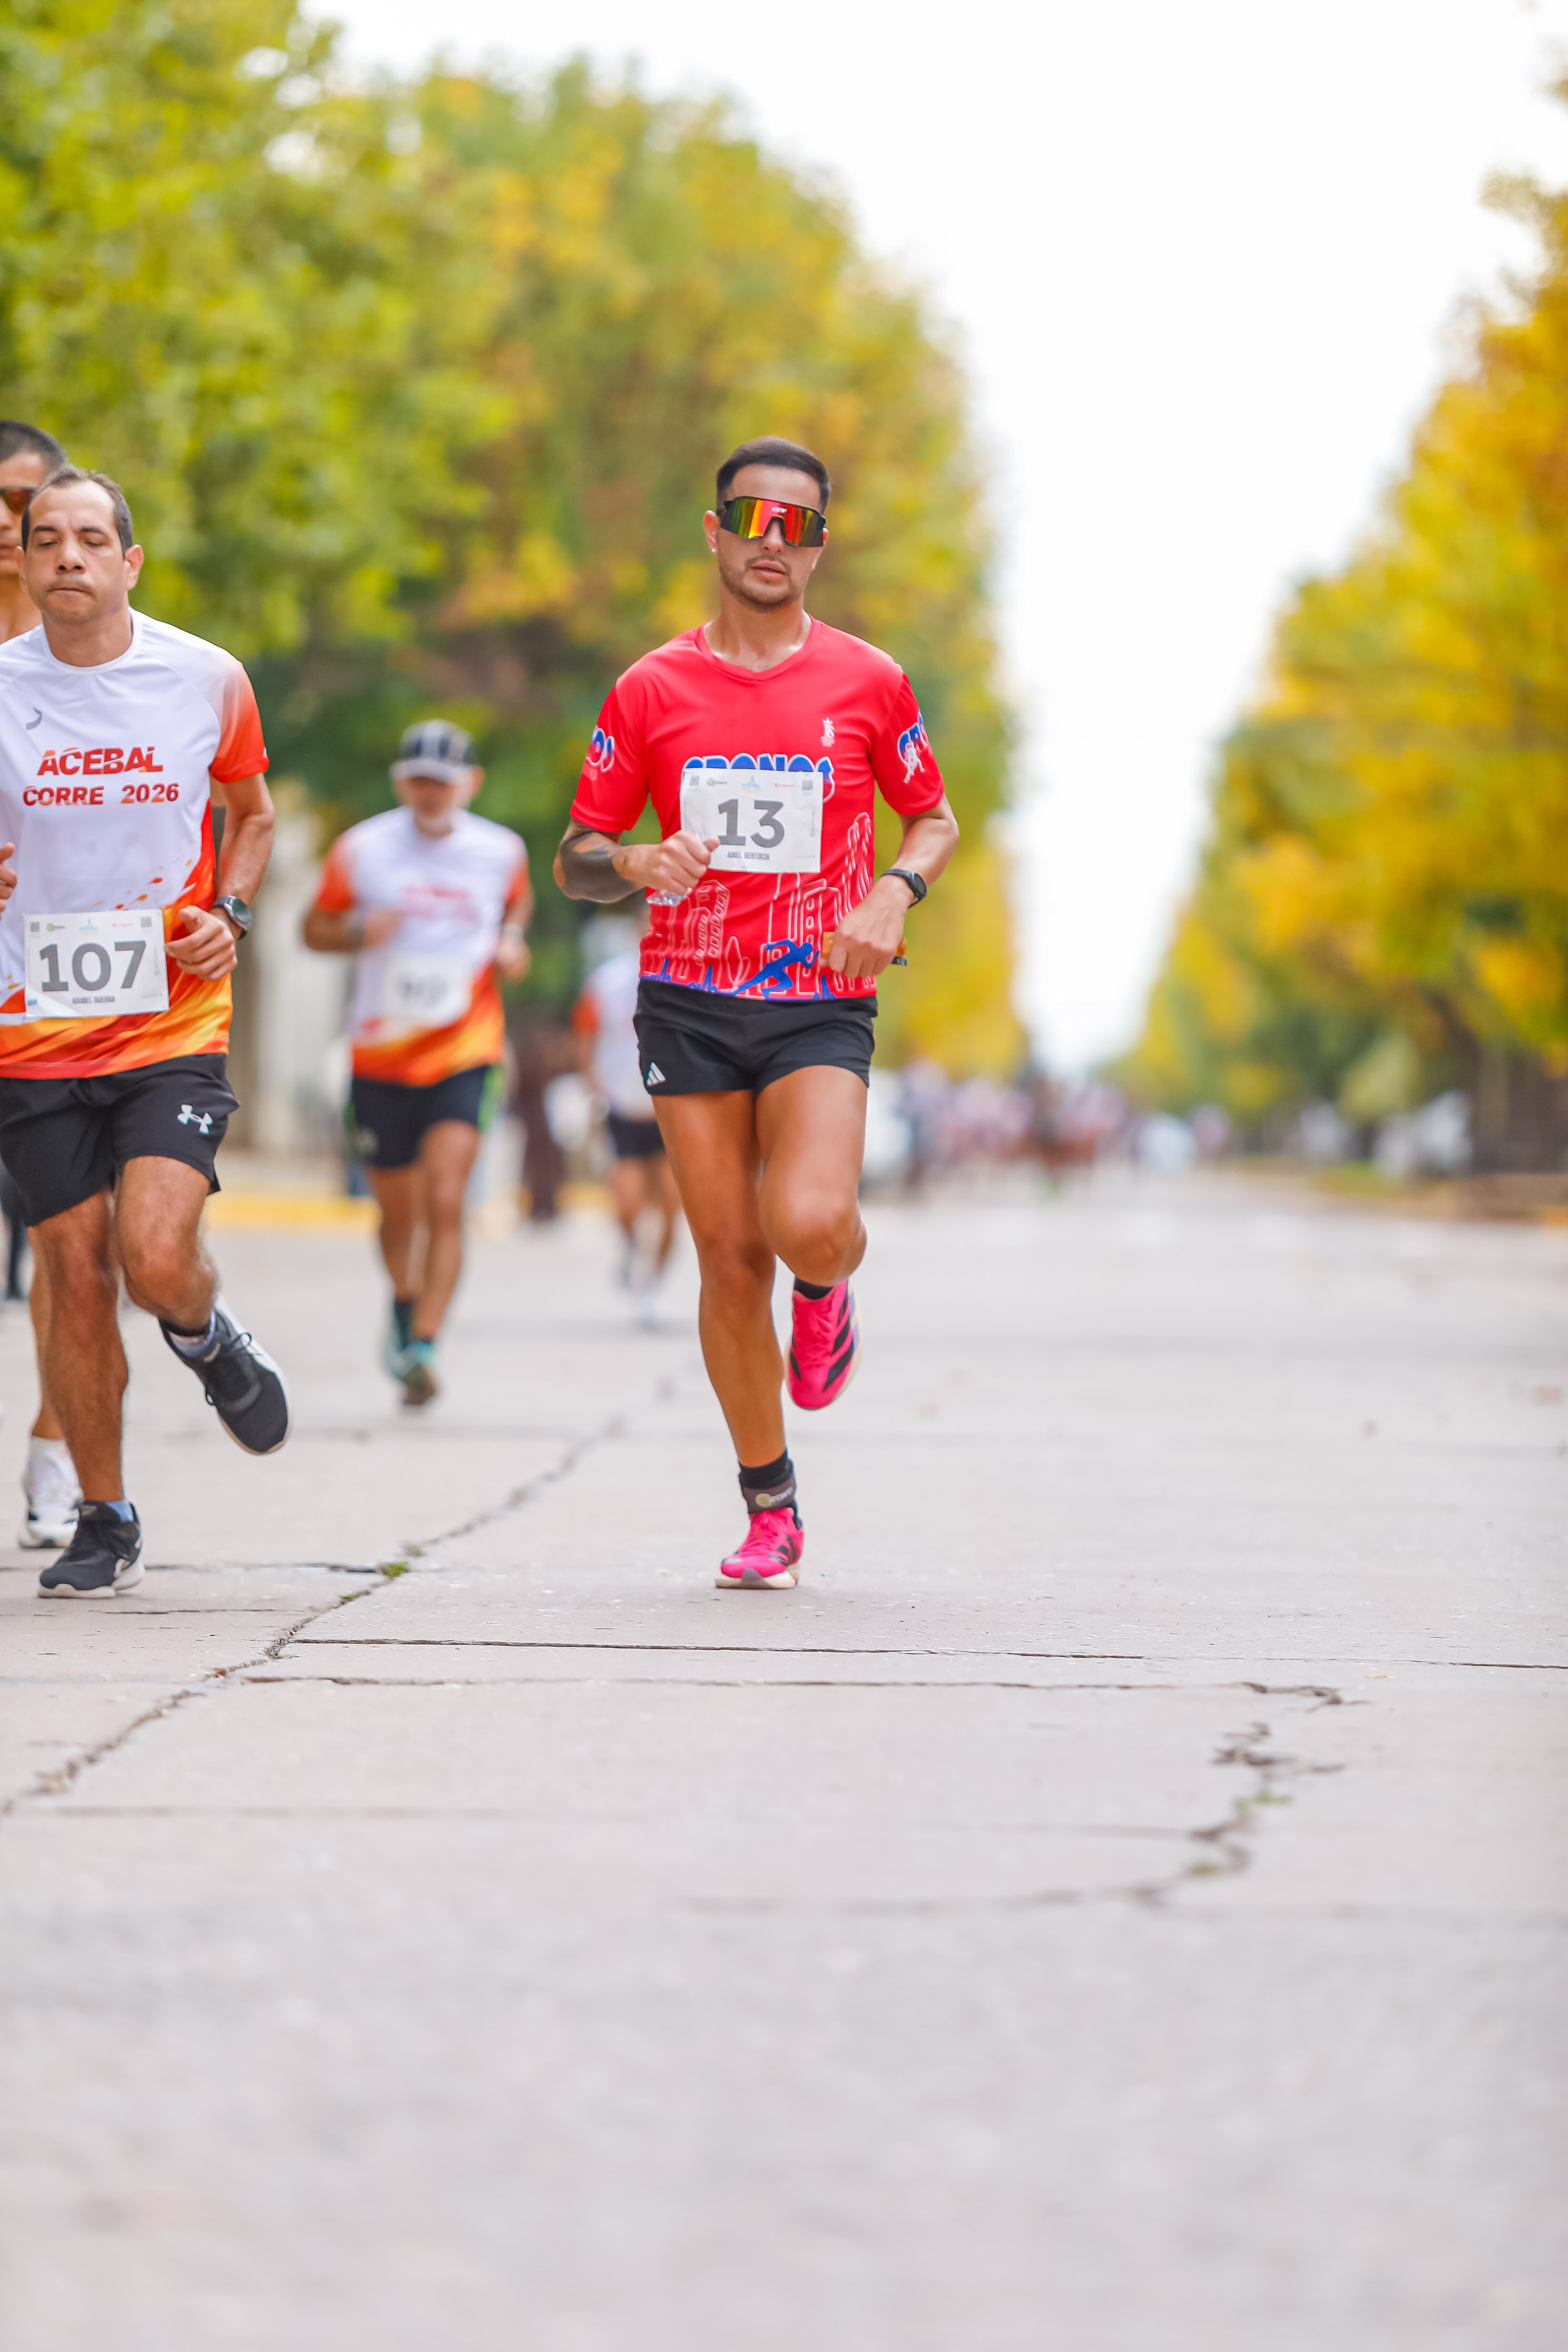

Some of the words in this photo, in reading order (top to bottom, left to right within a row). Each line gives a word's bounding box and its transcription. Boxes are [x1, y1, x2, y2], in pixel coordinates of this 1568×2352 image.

[36, 746, 163, 776] ACEBAL
[23, 785, 104, 806] CORRE
[120, 782, 179, 804] 2026
[717, 798, 785, 848] 13
[39, 939, 146, 992] 107
